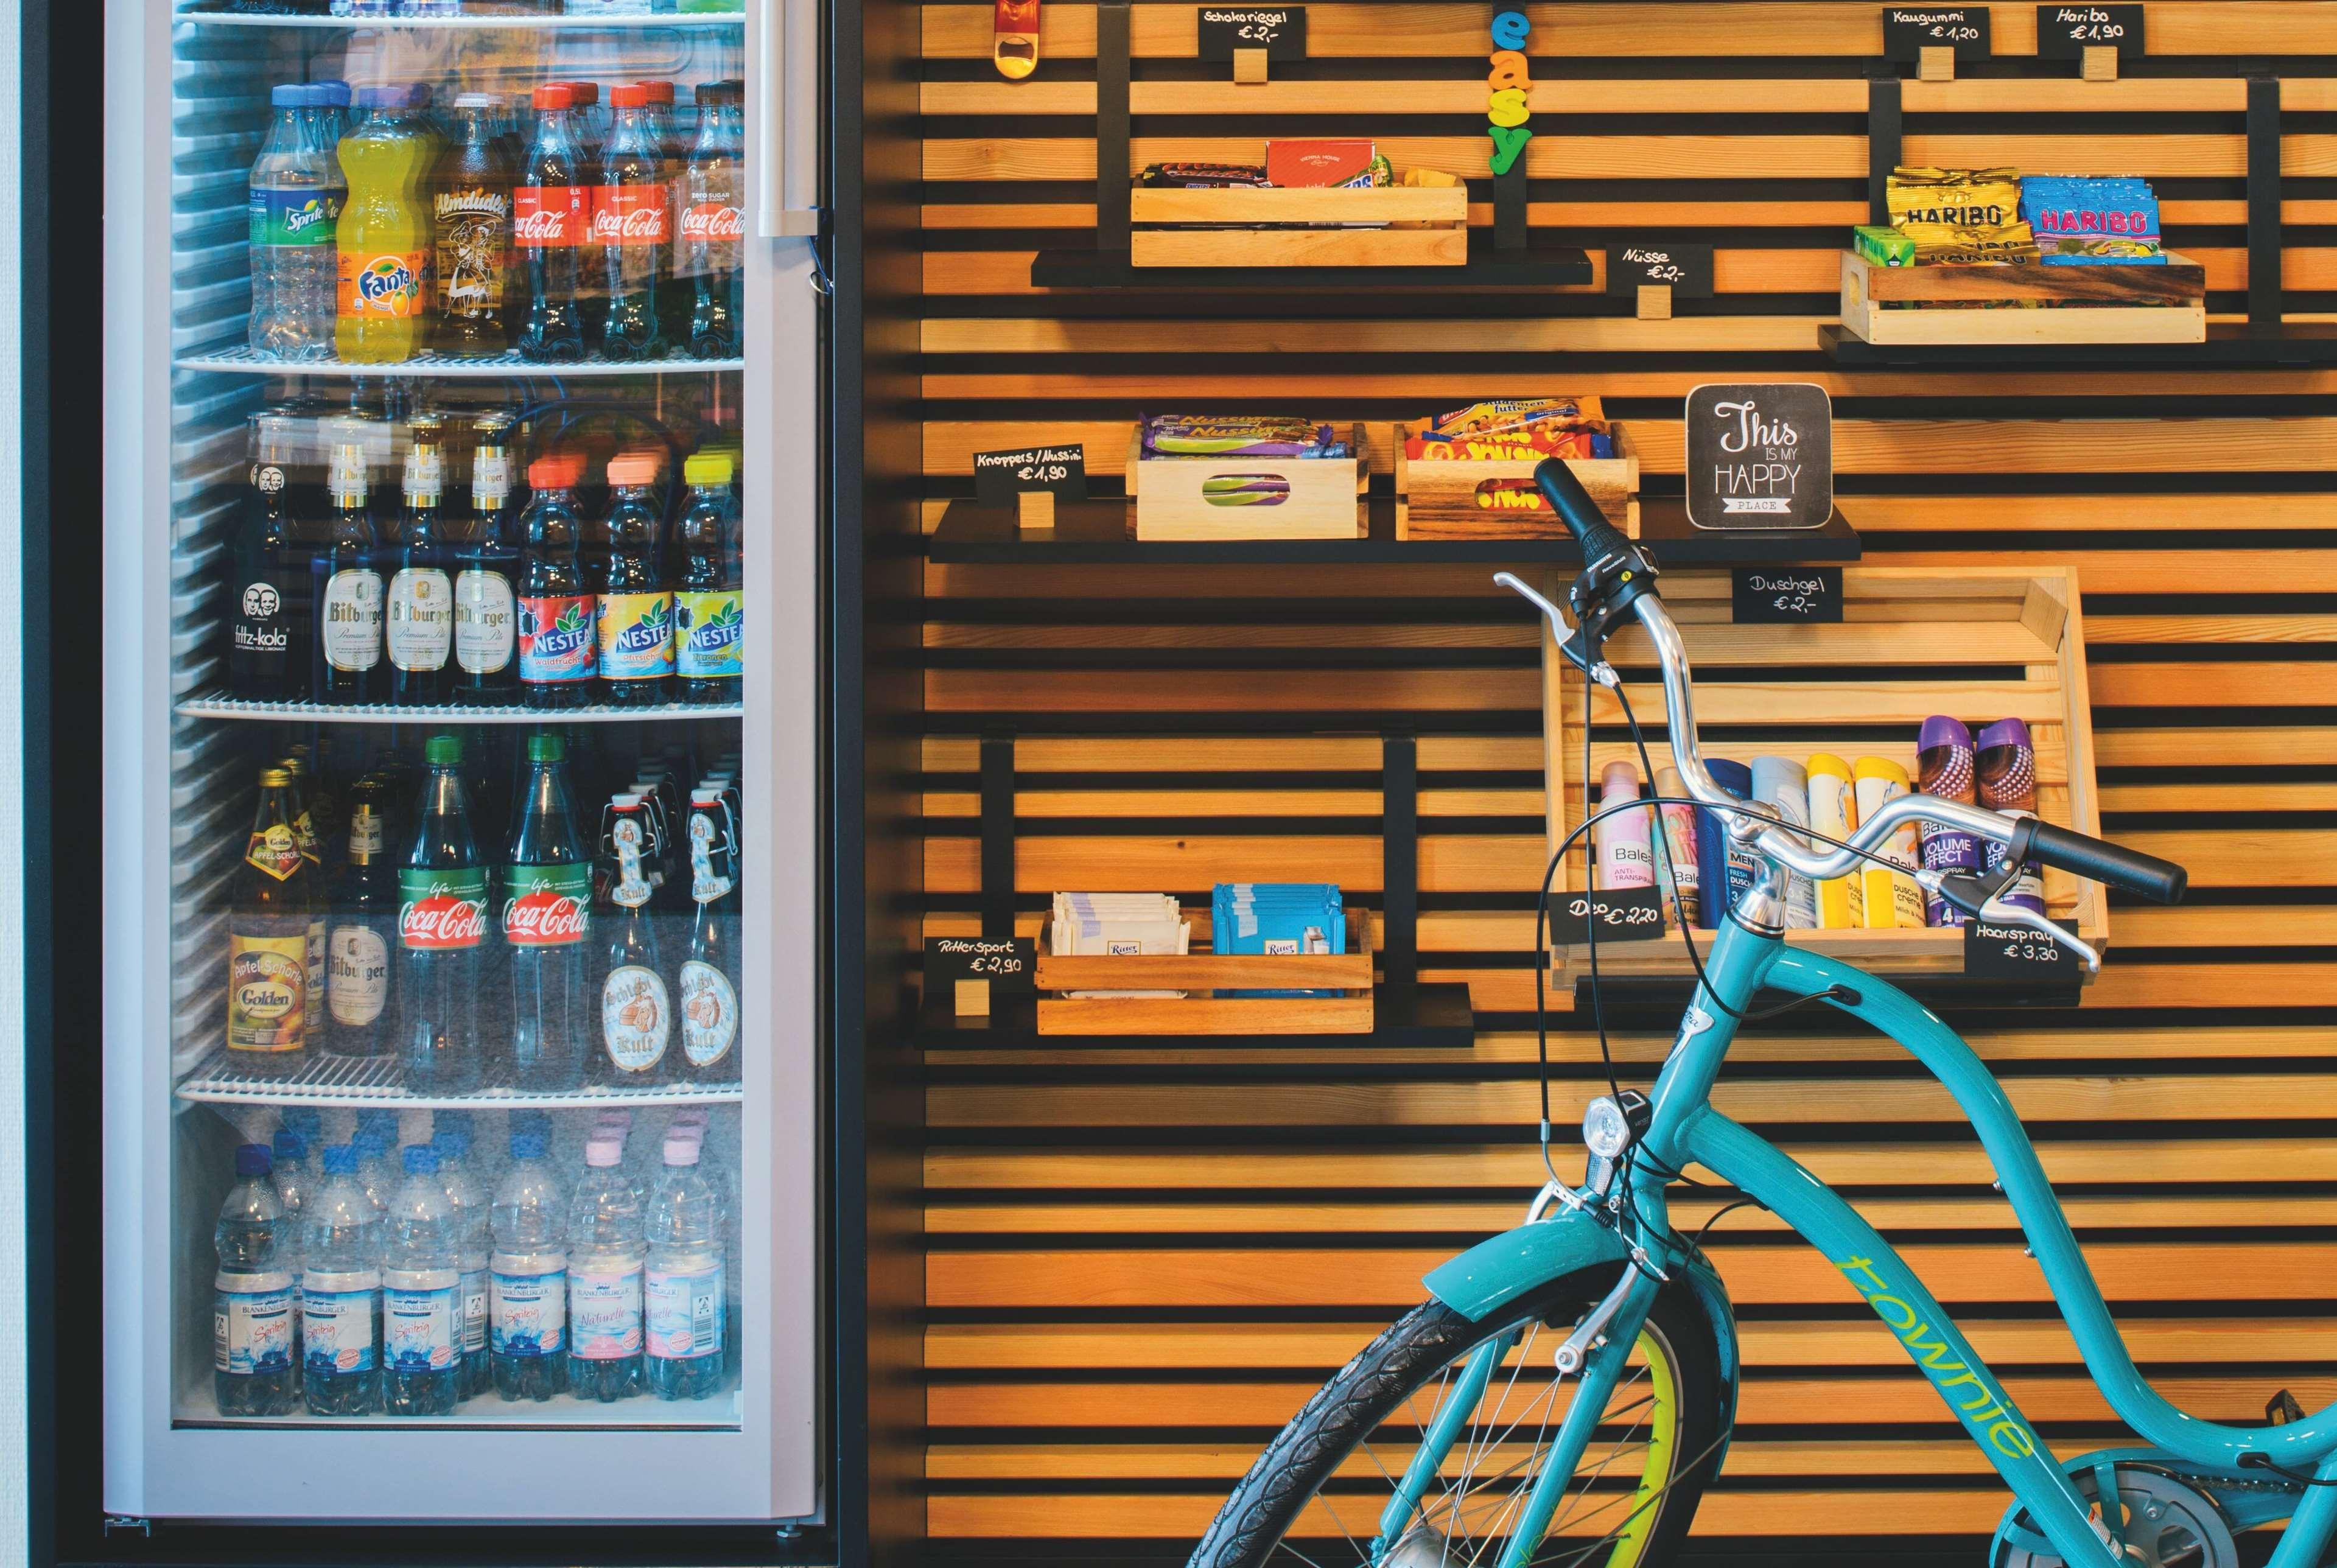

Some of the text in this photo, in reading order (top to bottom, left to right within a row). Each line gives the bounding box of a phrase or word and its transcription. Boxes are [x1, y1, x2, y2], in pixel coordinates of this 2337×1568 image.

[1204, 11, 1287, 27] Schokoriegel
[1893, 10, 1965, 26] Kaugummi
[2056, 8, 2109, 23] Haribo
[287, 204, 324, 231] Sprite
[595, 208, 664, 237] Coca-Cola
[681, 207, 745, 236] Coca-Cola
[1906, 204, 2002, 226] HARIBO
[2041, 209, 2147, 234] HARIBO
[1622, 248, 1670, 263] Nüsse
[359, 267, 410, 301] Fanta
[1714, 401, 1798, 452] This
[1765, 447, 1798, 461] IS MY
[1715, 464, 1801, 494] HAPPY
[1737, 501, 1777, 510] PLACE
[1749, 575, 1825, 595] Duschgel
[329, 601, 381, 625] Bitburge
[235, 625, 287, 646] fritz-kola
[396, 627, 429, 638] Premium
[534, 628, 592, 654] NESTEA
[617, 623, 673, 650] NESTEA
[536, 656, 580, 666] Waldfrucht
[1924, 838, 1972, 858] VOLUME
[1730, 852, 1755, 867] MEN
[1925, 850, 1963, 870] EFFECT
[1729, 869, 1748, 879] FRESH
[399, 897, 489, 939] Coca-Cola
[502, 893, 592, 939] Coca-Cola
[1942, 908, 1953, 923] 4
[1977, 924, 2055, 948] Haarspray
[1110, 945, 1138, 955] Ritter
[1267, 944, 1295, 954] Ritter
[242, 989, 289, 1005] Golden
[1833, 1255, 2034, 1460] townie
